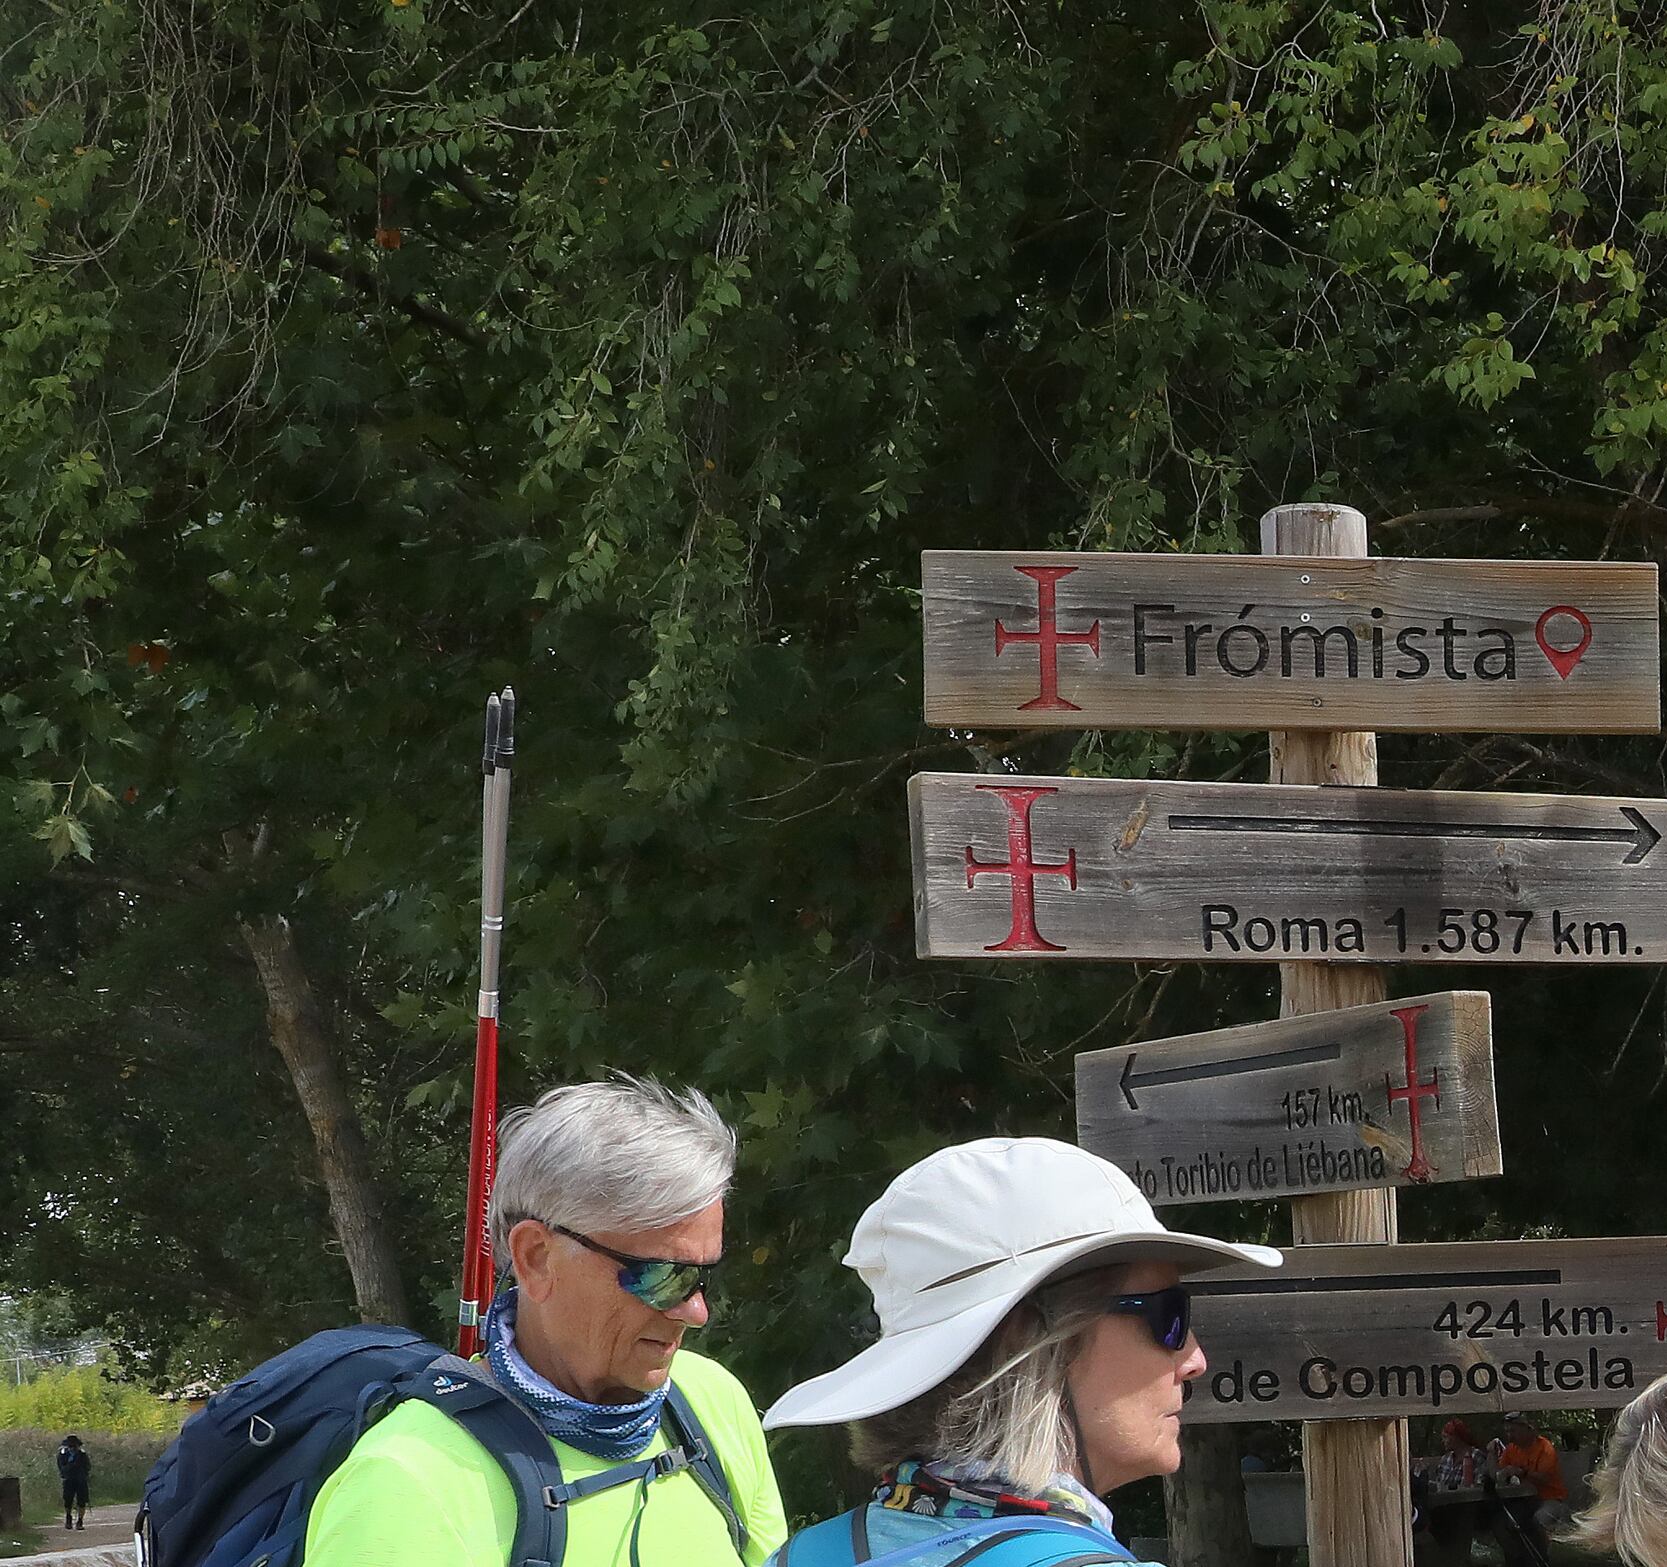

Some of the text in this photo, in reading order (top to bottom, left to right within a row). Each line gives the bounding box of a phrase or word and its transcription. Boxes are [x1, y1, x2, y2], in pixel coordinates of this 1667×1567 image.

[1133, 604, 1518, 681] Frómista
[1202, 904, 1645, 957] Roma 1.587 km.
[1281, 1084, 1373, 1131] 157 km.
[1126, 1141, 1386, 1199] nto Toribio de Liébana
[1432, 1297, 1630, 1340] 424 km.
[1211, 1360, 1281, 1403] de
[1299, 1348, 1636, 1408] Compostela
